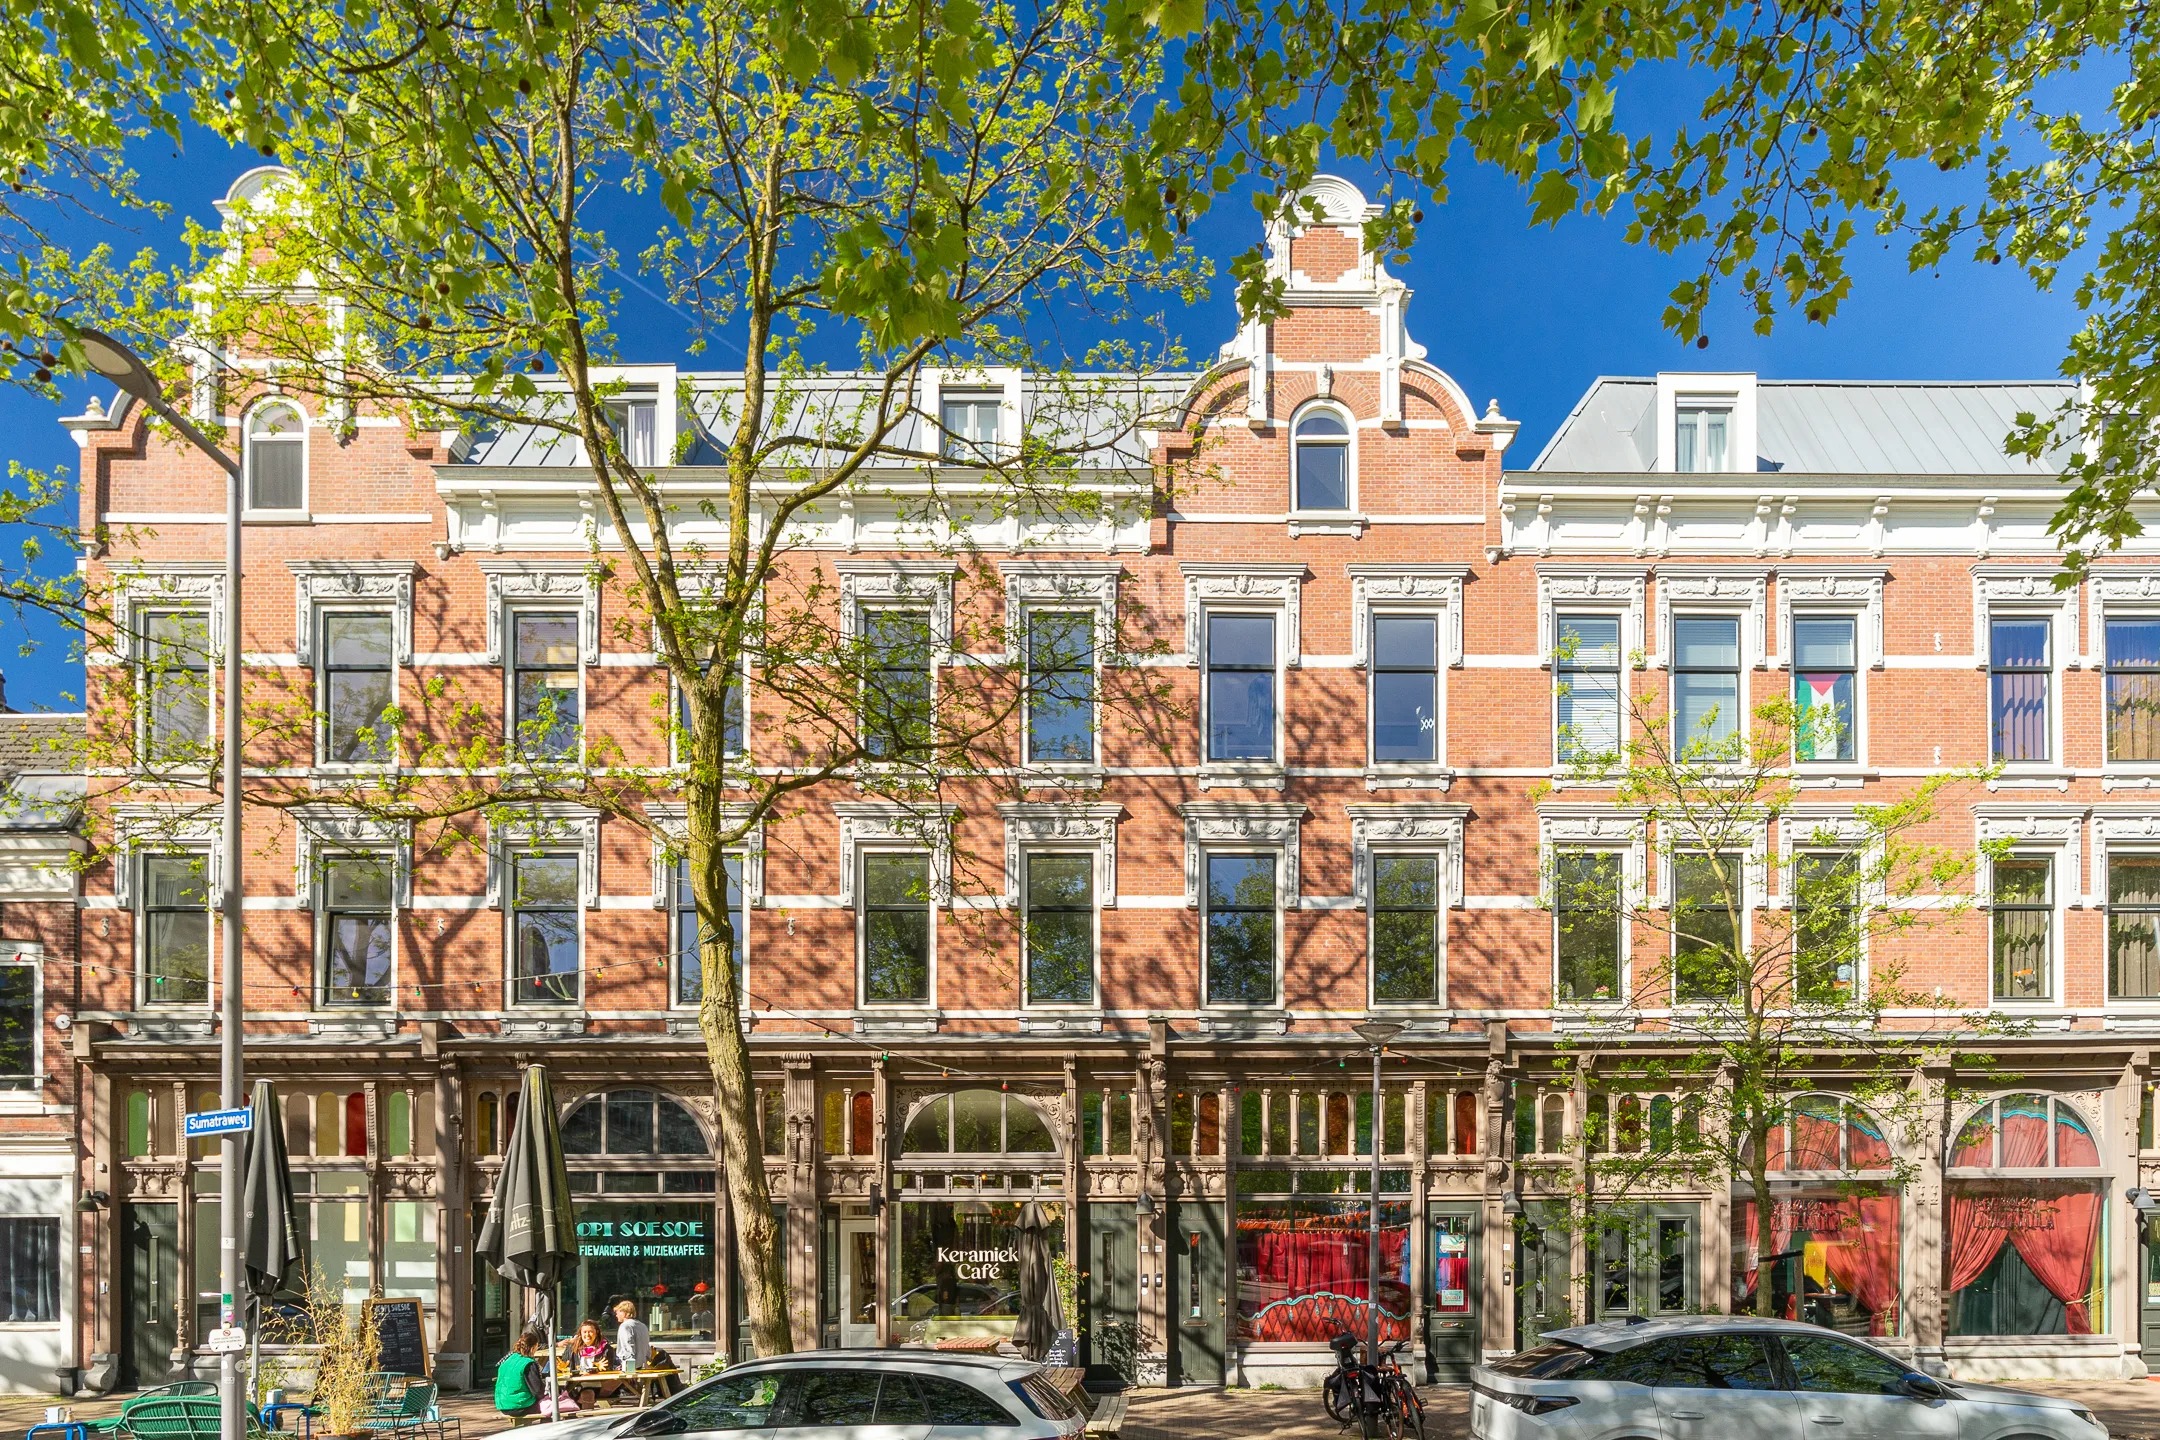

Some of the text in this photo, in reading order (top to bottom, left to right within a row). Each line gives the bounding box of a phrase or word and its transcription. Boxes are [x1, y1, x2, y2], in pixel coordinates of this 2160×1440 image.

[189, 1114, 247, 1130] Sumatraweg
[576, 1221, 705, 1238] OPI SOESOE
[578, 1244, 706, 1257] FIEWAROENG & MUZIEKKAFFEE
[937, 1246, 1020, 1263] Keramiek
[957, 1262, 1001, 1280] Café
